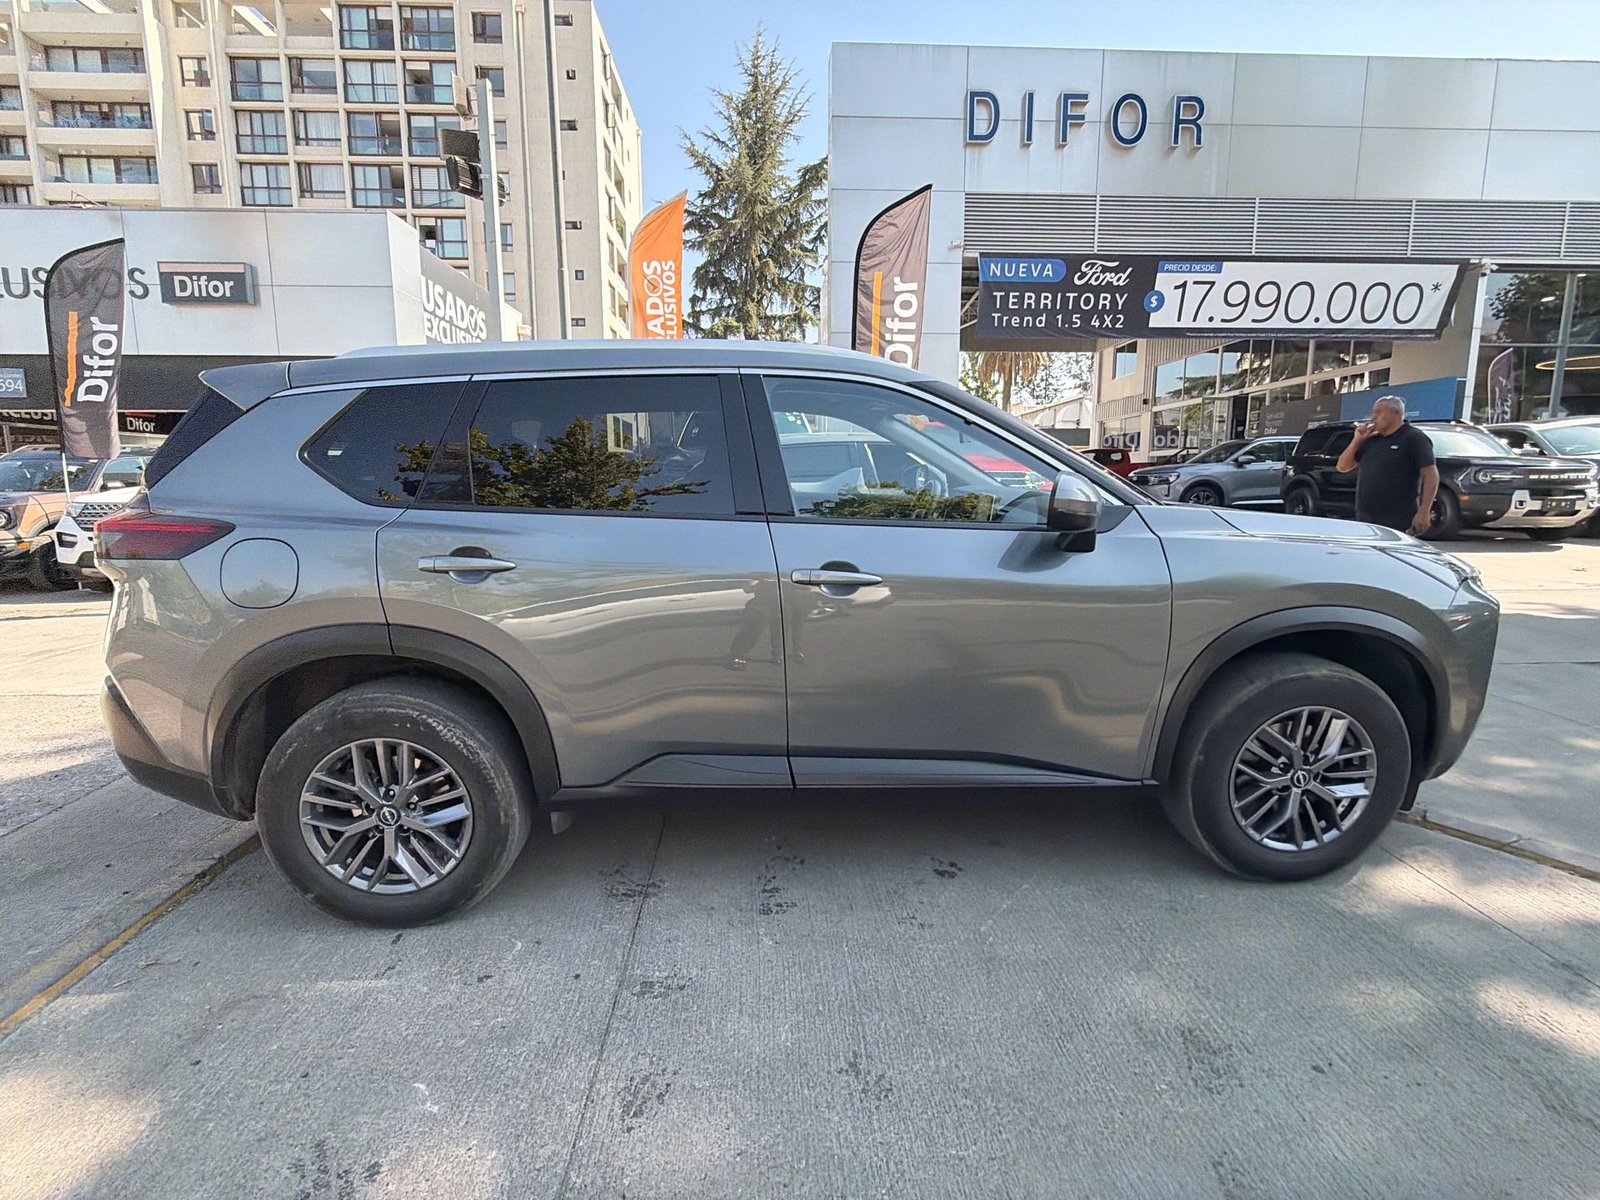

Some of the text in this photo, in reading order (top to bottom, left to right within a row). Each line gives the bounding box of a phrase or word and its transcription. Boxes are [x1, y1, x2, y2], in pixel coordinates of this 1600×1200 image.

[965, 89, 1206, 149] DIFOR
[173, 275, 235, 298] Difor
[989, 259, 1133, 286] NUEVA Ford
[1164, 264, 1217, 273] PRECIO DESDE:
[420, 275, 488, 340] USADOS
[642, 260, 665, 340] ADOS
[662, 260, 677, 340] LUSIVOS
[992, 291, 1128, 310] TERRITORY
[992, 313, 1125, 328] Trend 1.5 4X2
[884, 276, 918, 369] Difor
[77, 316, 118, 403] Difor
[126, 417, 156, 432] Difor
